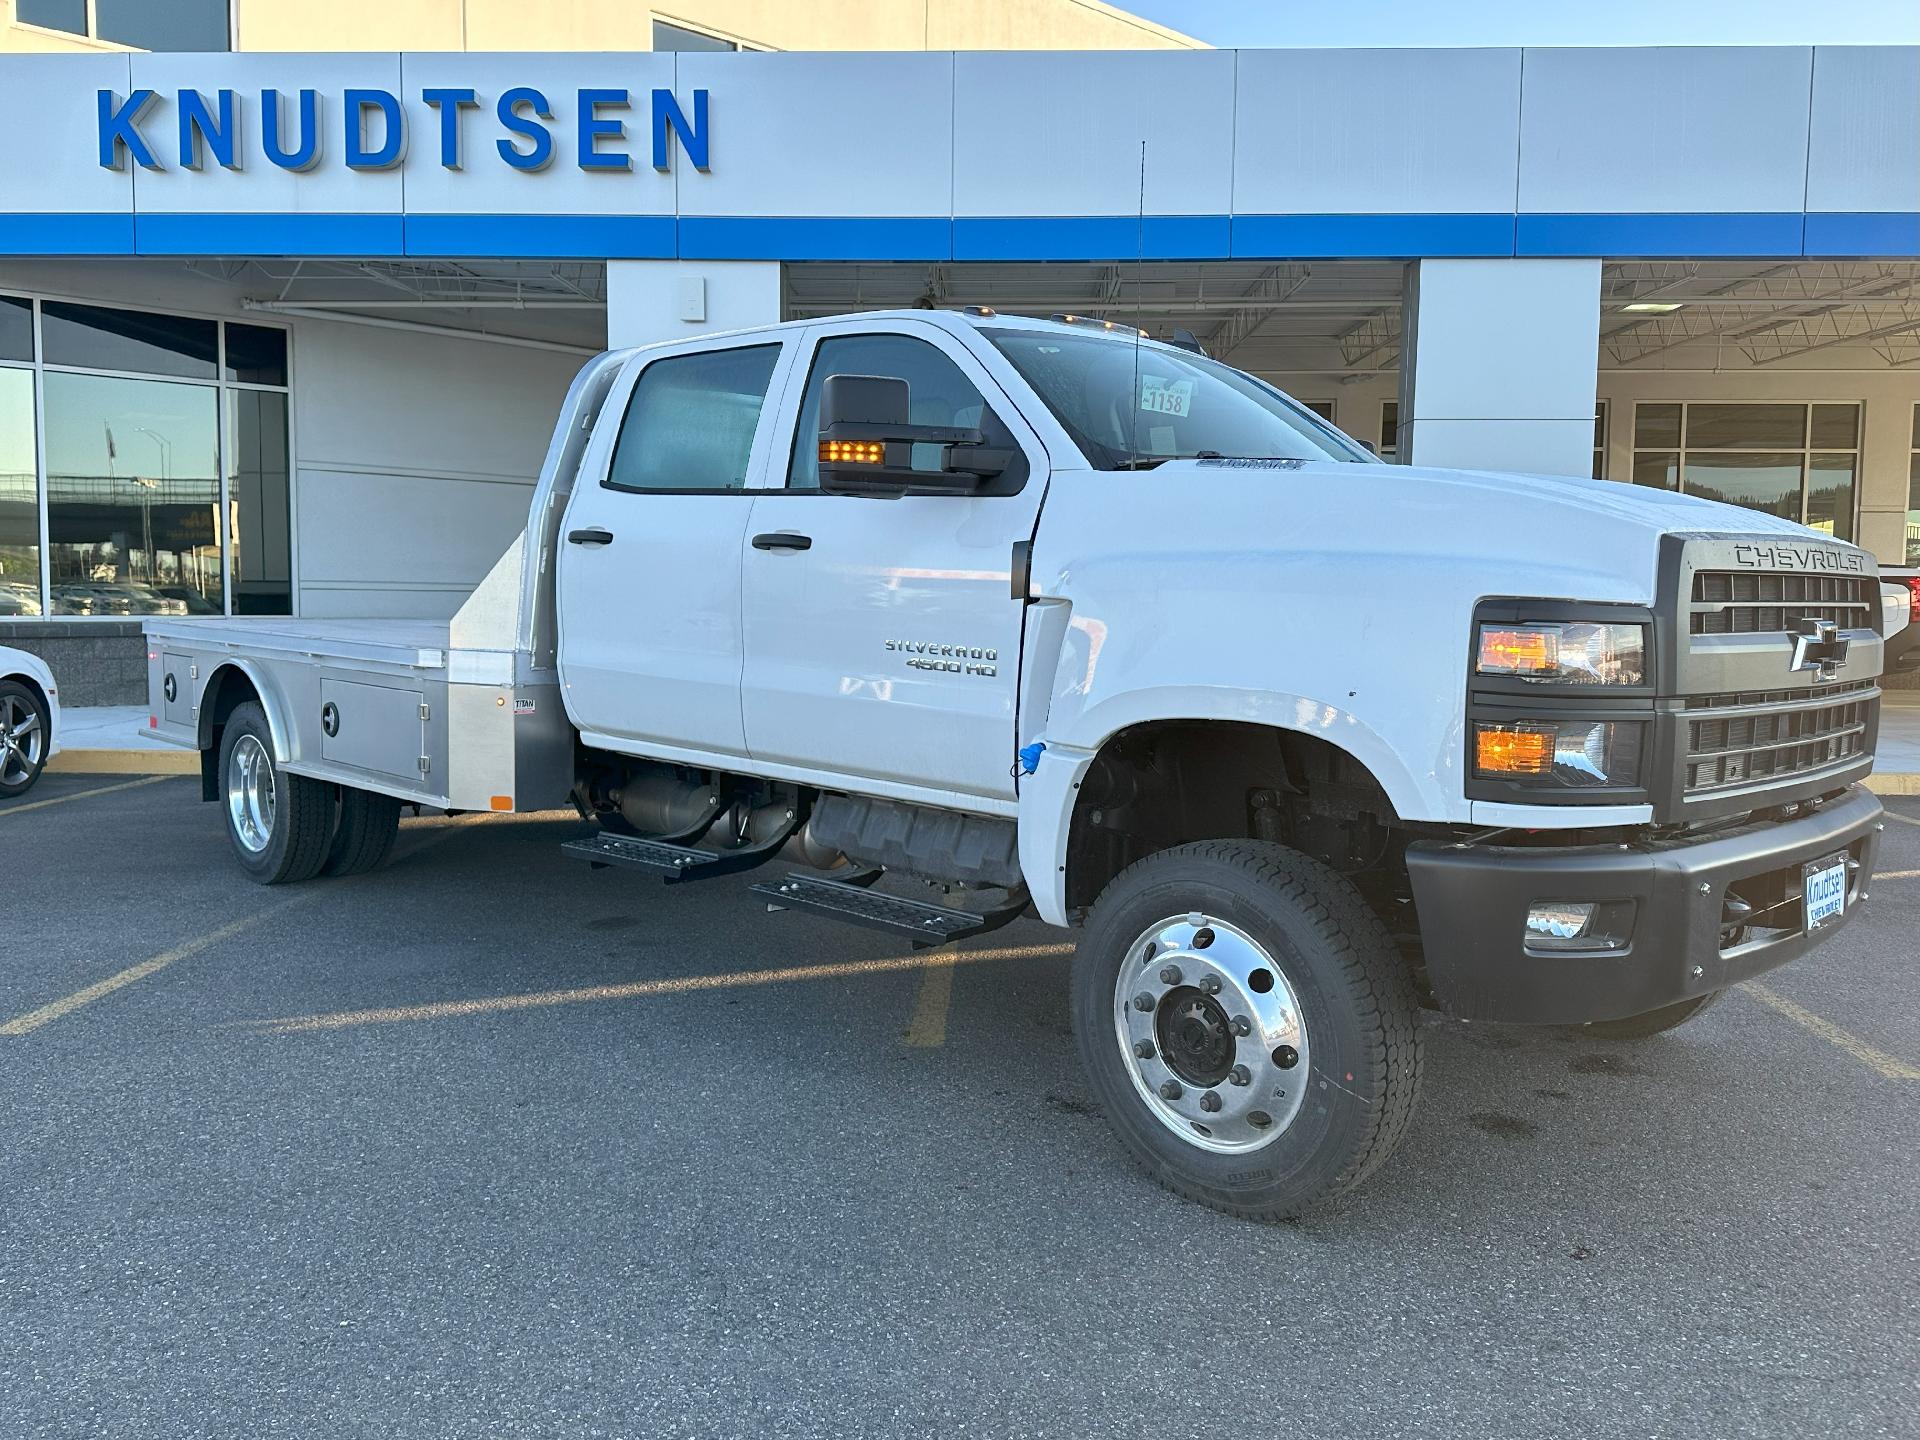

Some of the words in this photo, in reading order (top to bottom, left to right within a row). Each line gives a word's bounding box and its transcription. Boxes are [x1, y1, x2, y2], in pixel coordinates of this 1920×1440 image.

[98, 88, 711, 172] KNUDTSEN
[1150, 391, 1182, 413] 1158
[1734, 545, 1863, 572] CHEVROLET
[885, 639, 997, 660] SILVERADO
[906, 658, 961, 673] 4500
[966, 662, 997, 677] HD
[516, 700, 533, 708] TITAN
[1807, 871, 1844, 905] Knudtsen
